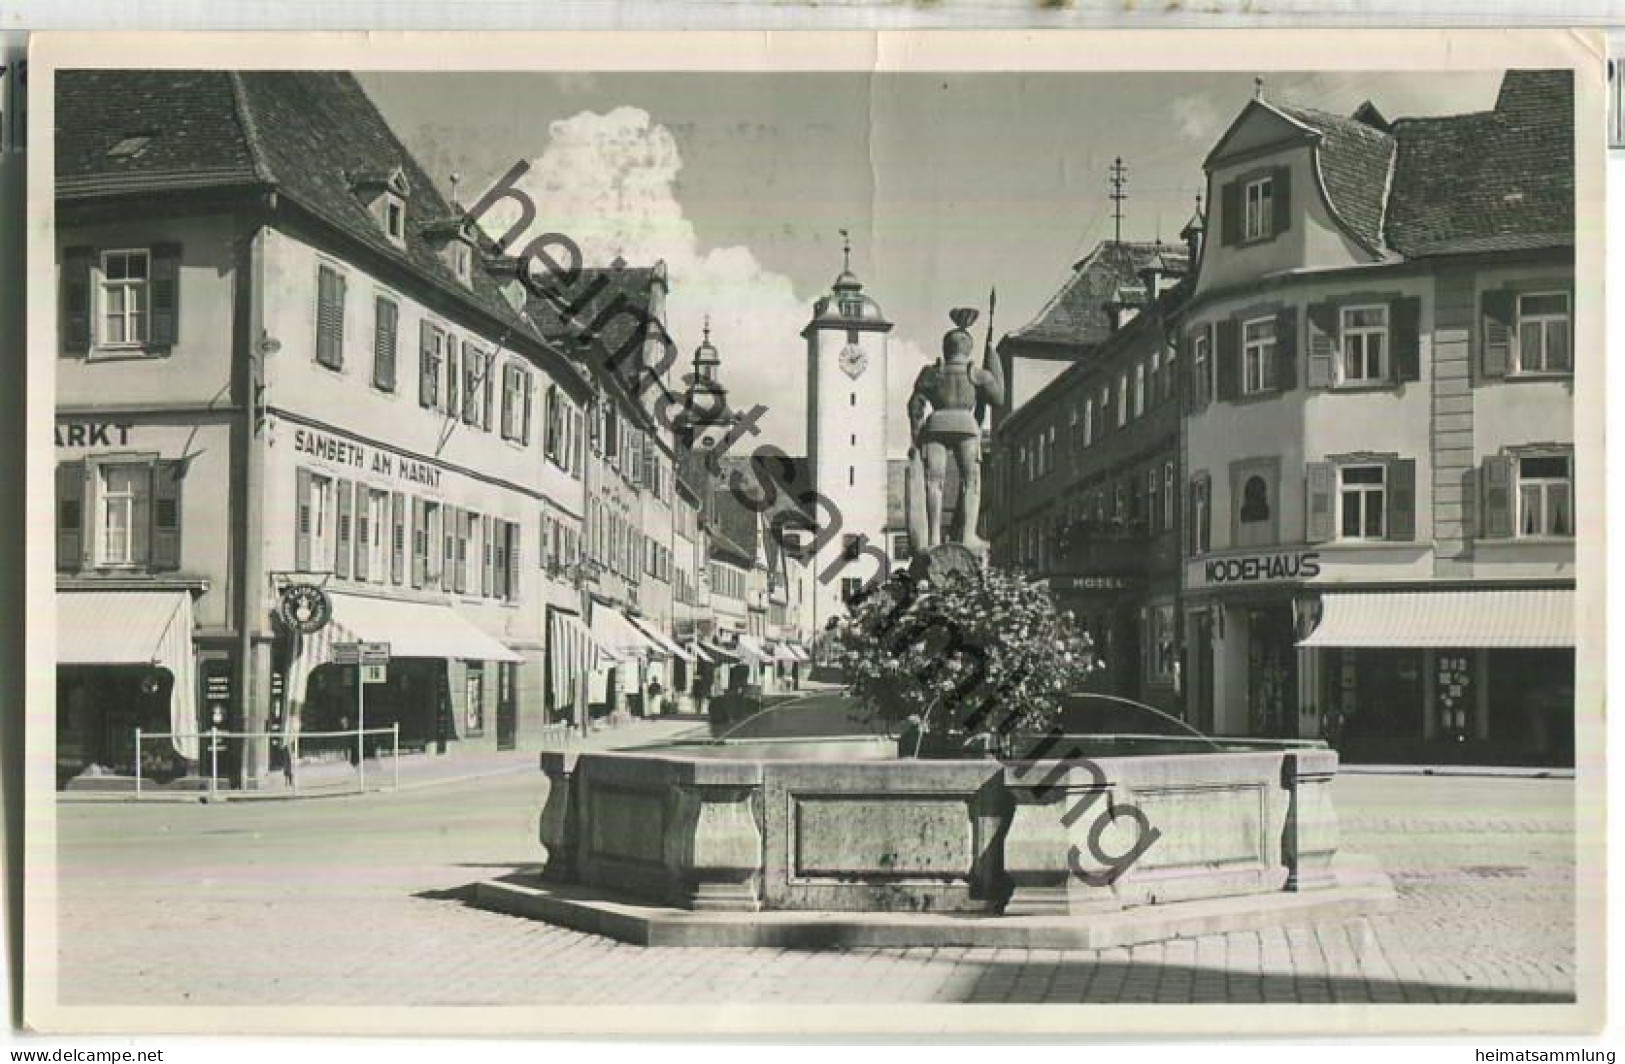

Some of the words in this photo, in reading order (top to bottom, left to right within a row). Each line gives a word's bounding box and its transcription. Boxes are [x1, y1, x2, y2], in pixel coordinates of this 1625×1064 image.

[294, 429, 364, 469] SAMBETH
[372, 451, 392, 476] AM
[399, 459, 442, 488] MARKT
[1205, 553, 1321, 583] MODEHAUS
